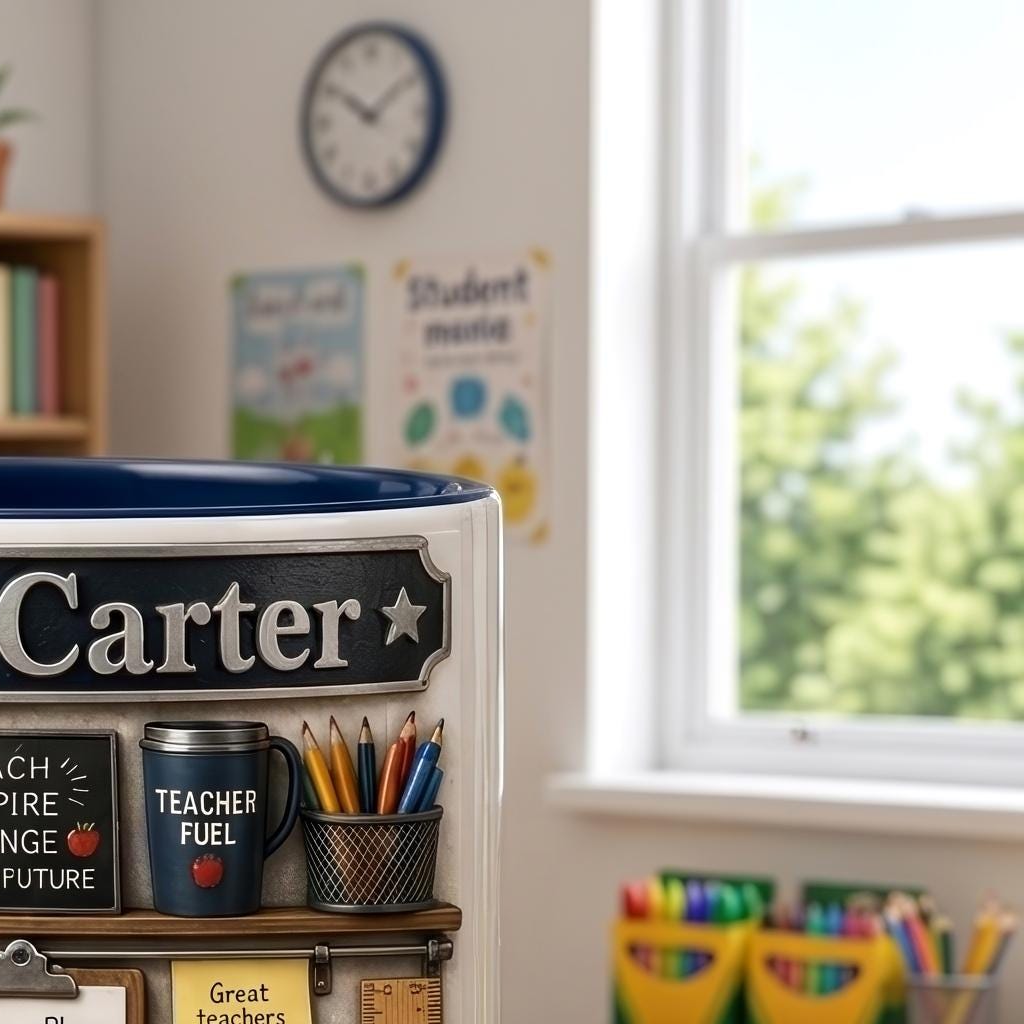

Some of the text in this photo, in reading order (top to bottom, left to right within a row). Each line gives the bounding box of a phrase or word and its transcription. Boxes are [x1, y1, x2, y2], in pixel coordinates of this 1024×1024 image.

[155, 789, 257, 816] TEACHER
[181, 822, 237, 846] FUEL
[210, 982, 269, 1003] Great
